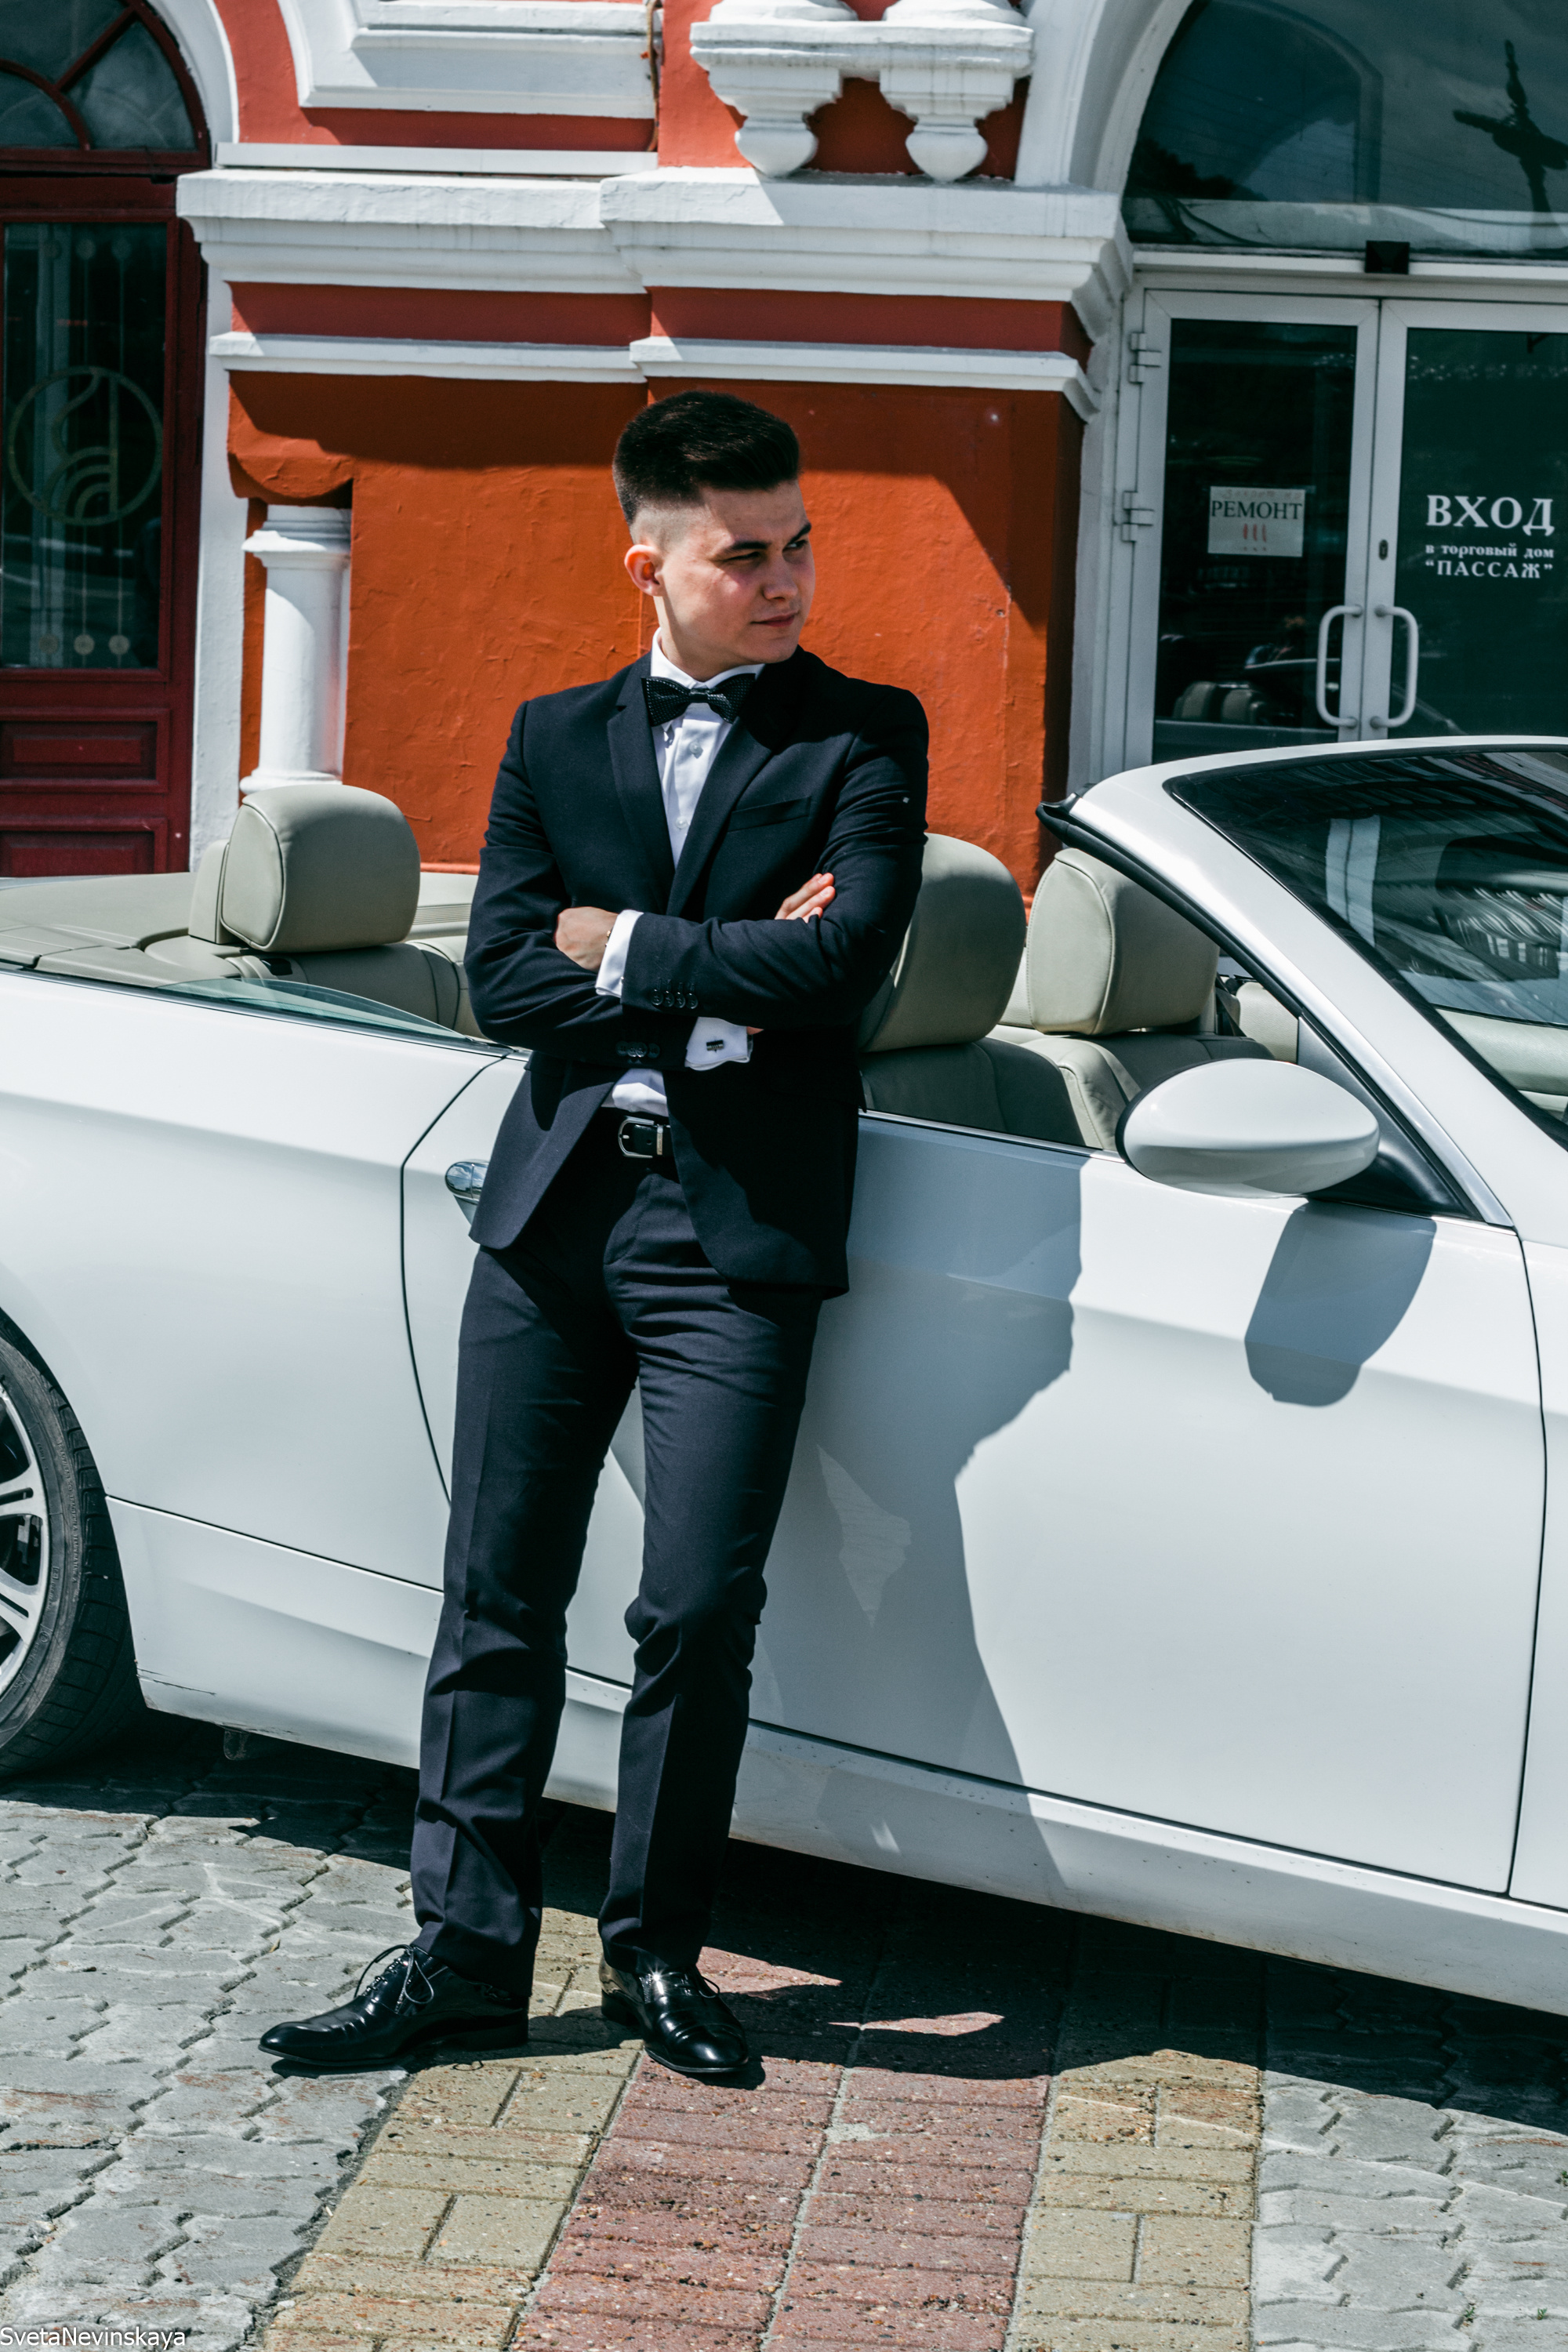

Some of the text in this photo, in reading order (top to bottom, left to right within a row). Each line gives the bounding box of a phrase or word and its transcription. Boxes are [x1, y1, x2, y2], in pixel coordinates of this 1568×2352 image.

[1210, 499, 1303, 520] РЕМОНТ
[1425, 494, 1555, 536] ВХОД
[1425, 542, 1554, 559] в торговый дом
